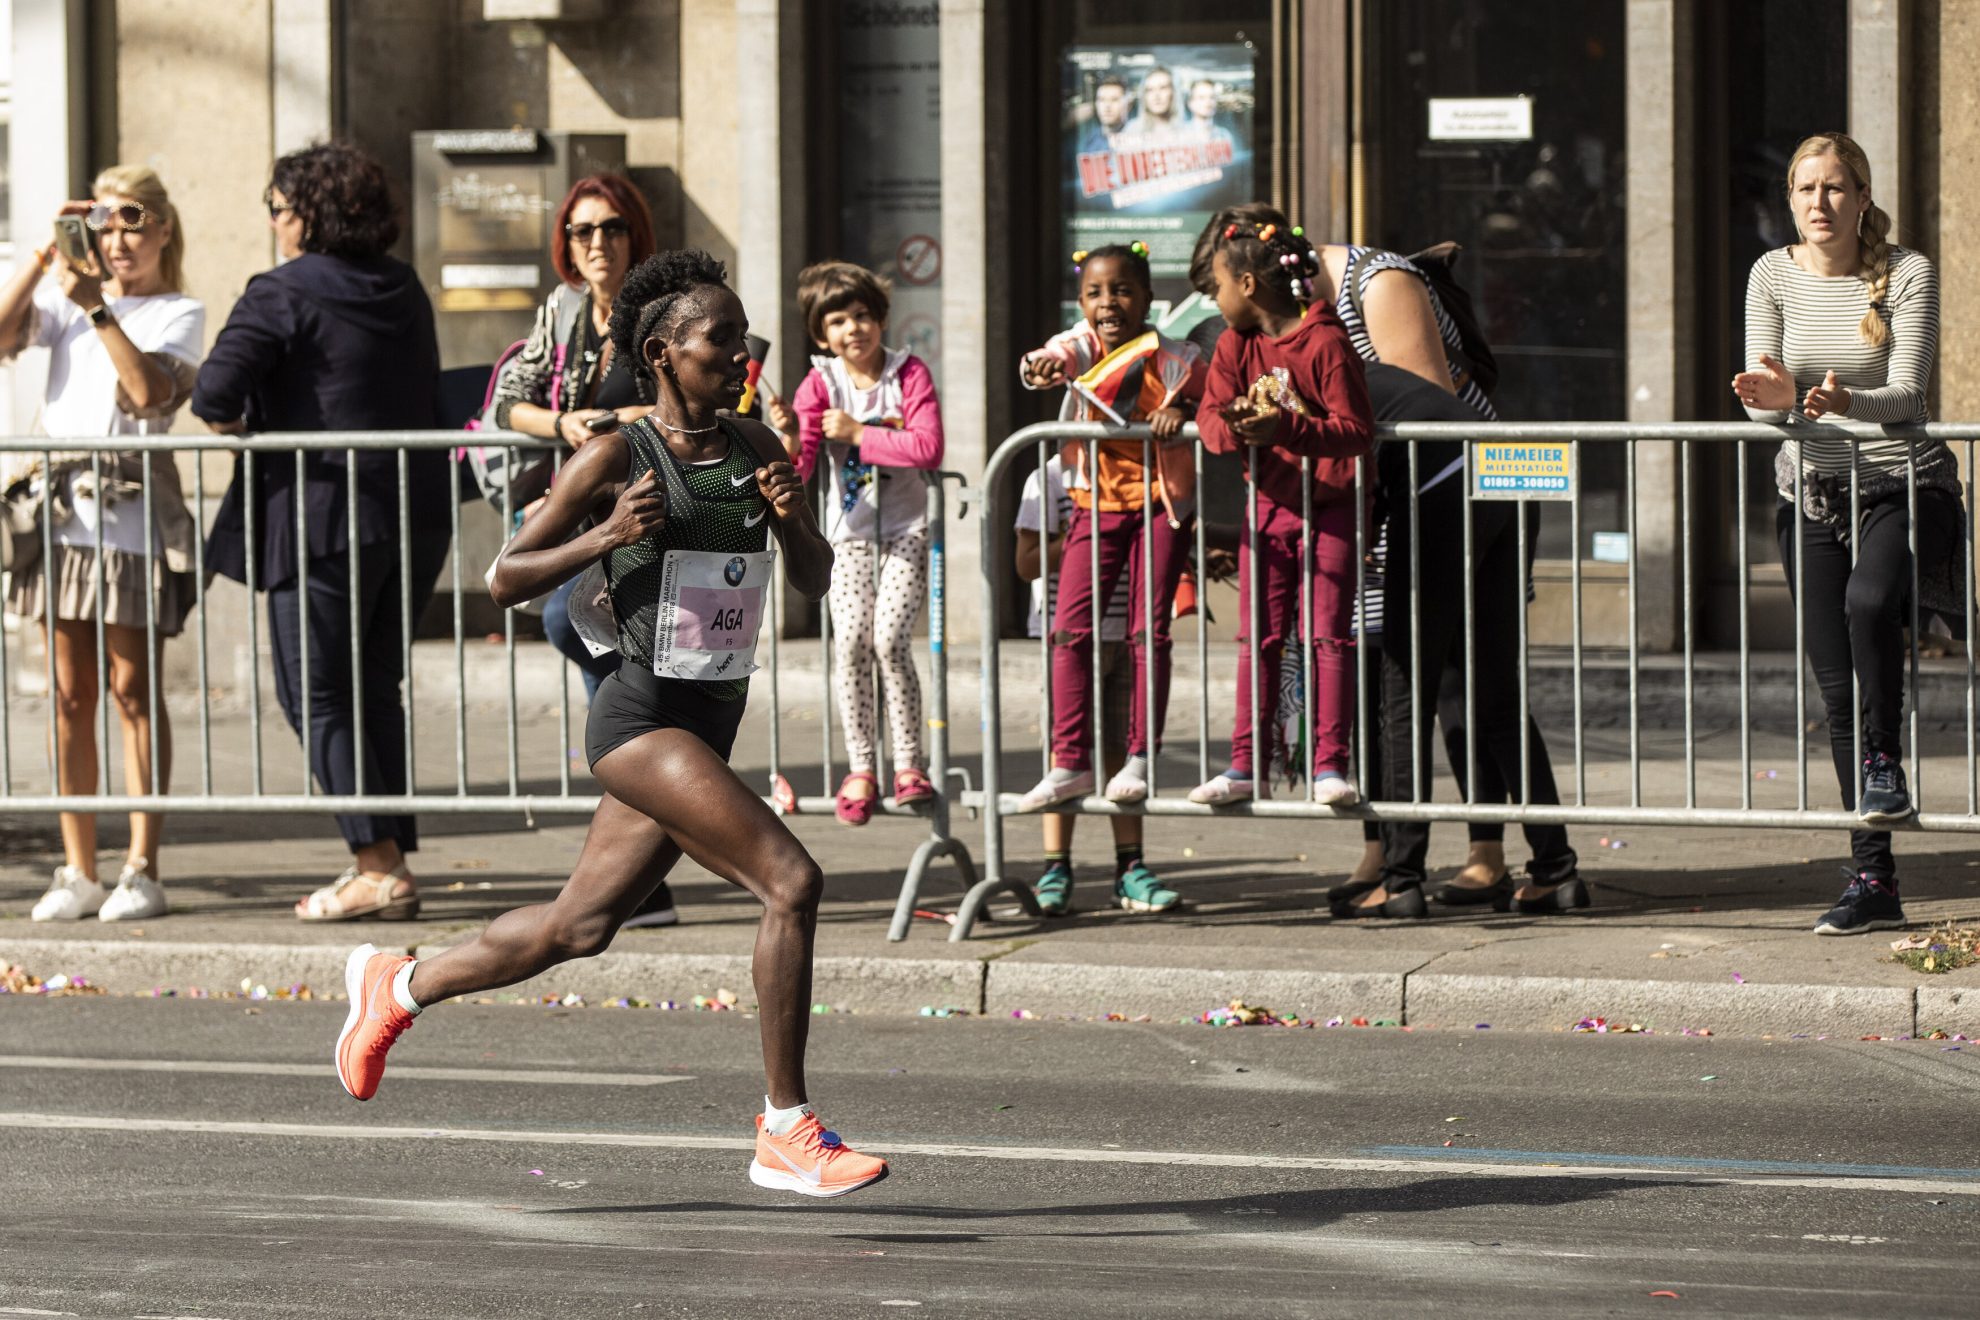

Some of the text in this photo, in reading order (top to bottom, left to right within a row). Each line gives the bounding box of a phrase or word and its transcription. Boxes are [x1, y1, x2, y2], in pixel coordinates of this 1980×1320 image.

[1485, 448, 1562, 461] NIEMEIER
[1485, 464, 1562, 472] MIETSTATION
[1483, 477, 1565, 488] 01805-308050
[660, 561, 673, 631] BERLIN-MARATHON
[711, 608, 743, 631] AGA
[665, 619, 674, 652] September
[718, 652, 735, 674] here
